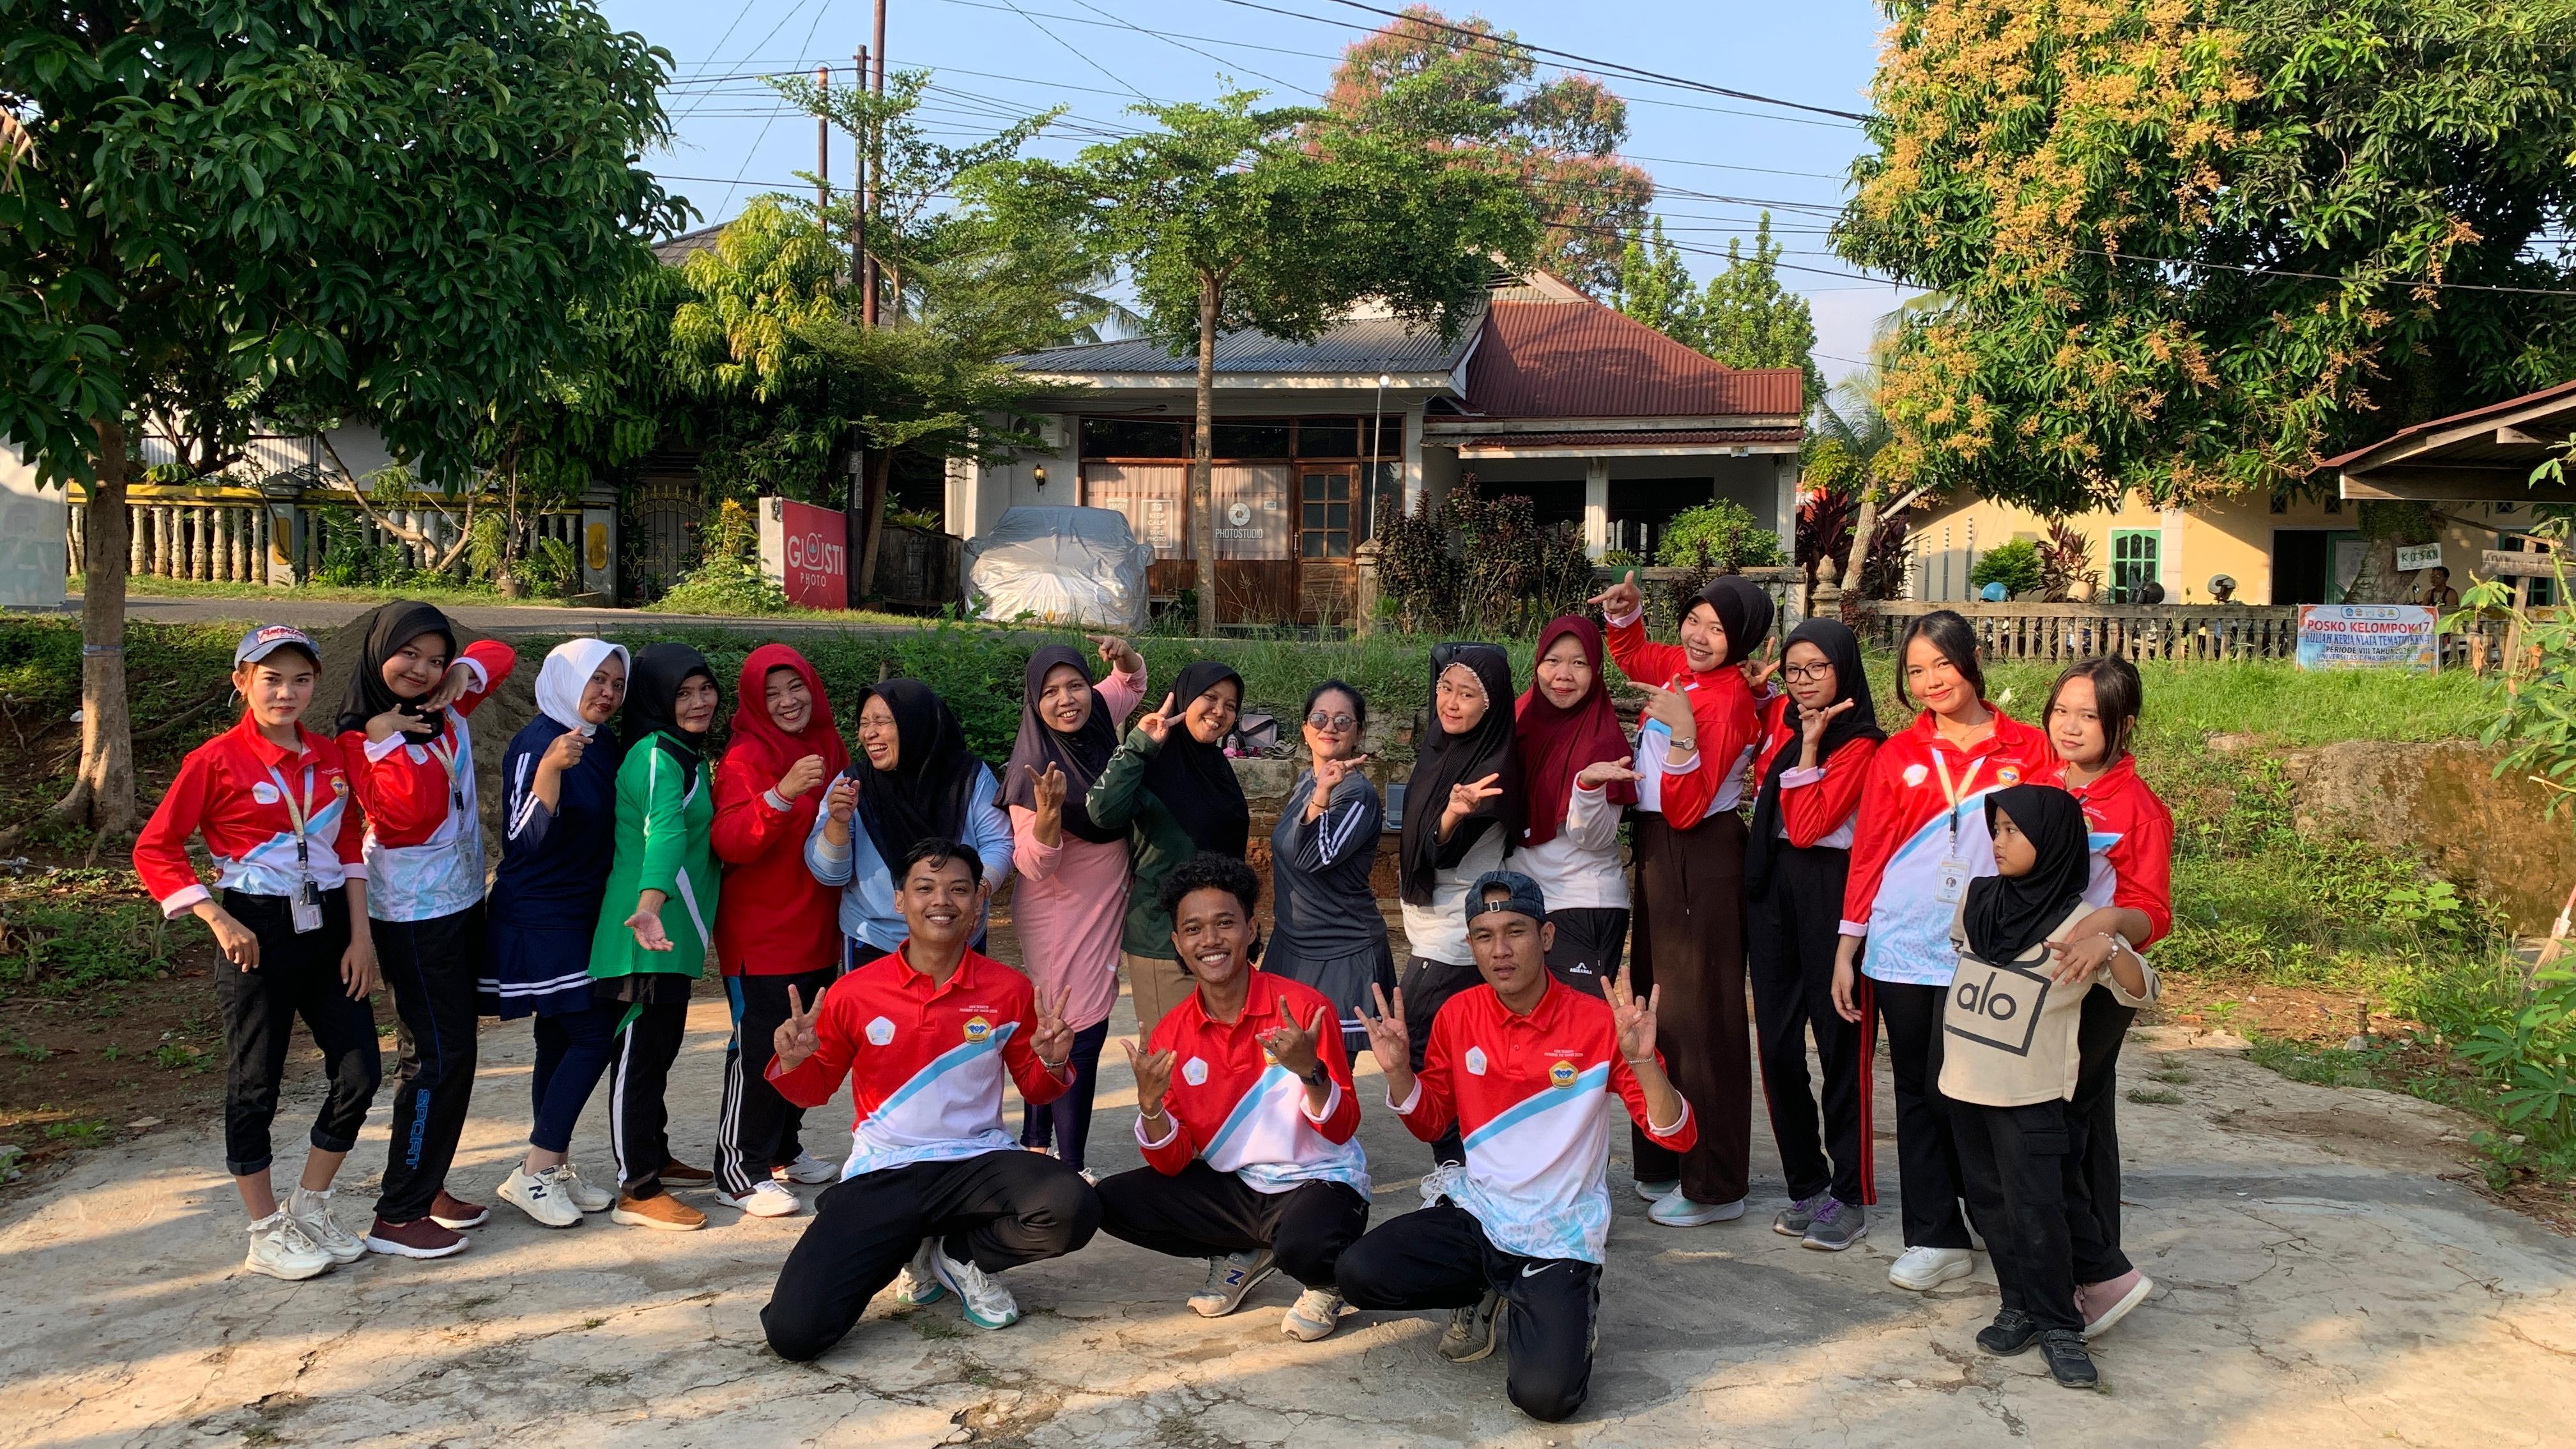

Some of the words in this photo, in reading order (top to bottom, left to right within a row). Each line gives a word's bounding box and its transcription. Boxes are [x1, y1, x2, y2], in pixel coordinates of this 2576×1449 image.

[1215, 528, 1263, 539] PHOTOSTUDIO
[800, 572, 827, 587] PHOTO
[2308, 620, 2346, 632] POSKO
[2350, 622, 2415, 634] KELOMPOK
[2418, 622, 2430, 632] 17
[2306, 632, 2332, 644] KULIAH
[2334, 633, 2354, 645] KERJA
[1956, 971, 2017, 1021] alo
[406, 1089, 430, 1170] SPORT
